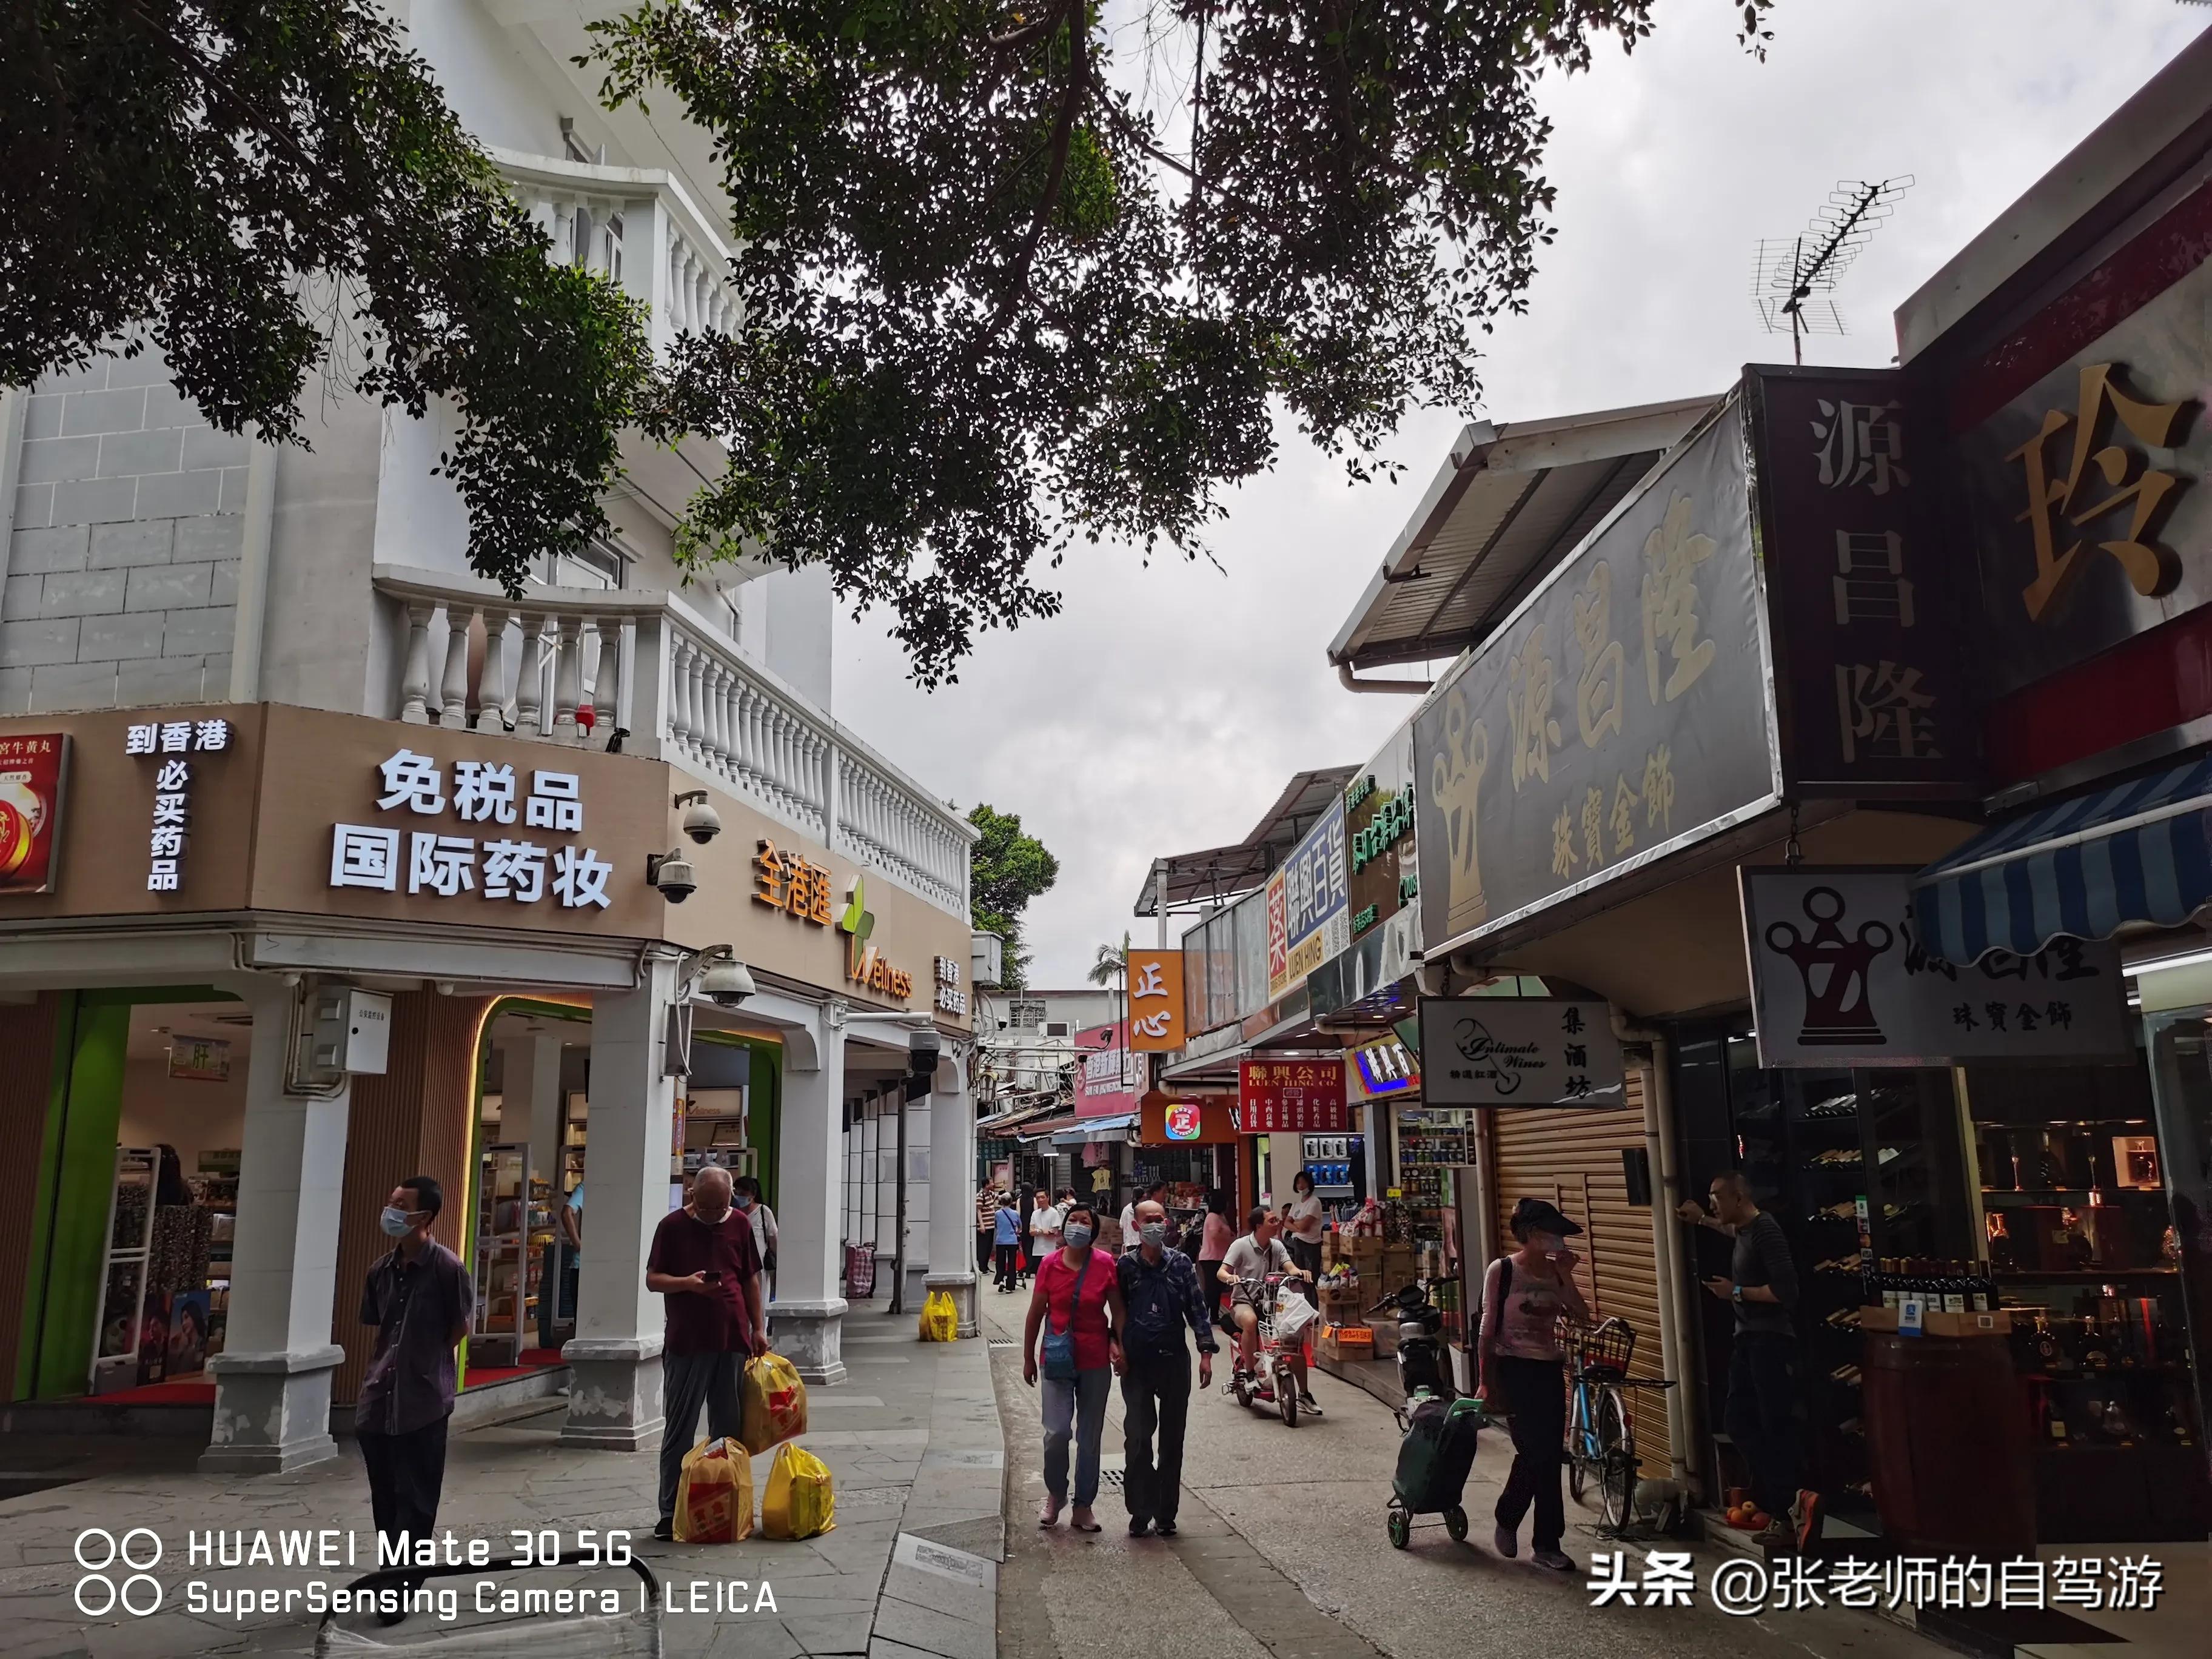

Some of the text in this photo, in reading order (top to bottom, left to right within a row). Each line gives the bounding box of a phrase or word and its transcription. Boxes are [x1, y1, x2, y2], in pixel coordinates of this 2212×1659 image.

[2004, 363, 2183, 623] 玲
[1809, 398, 1944, 764] 源昌隆
[126, 719, 228, 754] 到香港
[376, 748, 583, 833] 免税品
[1552, 743, 1676, 879] 珠寶金飾
[147, 760, 189, 891] 必买药品
[330, 822, 614, 910] 国际药妆
[851, 934, 914, 999] Wellness
[938, 956, 959, 985] 到香港
[1289, 936, 1322, 979] LUEN HING
[939, 985, 967, 1016] 必买药品
[1133, 962, 1171, 1037] 正心
[1953, 1000, 2073, 1033] 珠寶金飾
[1248, 1065, 1336, 1080] 聯興公司
[1462, 1037, 1540, 1055] Intimate
[1503, 1054, 1547, 1070] Wines
[1561, 1007, 1592, 1100] 集酒坊
